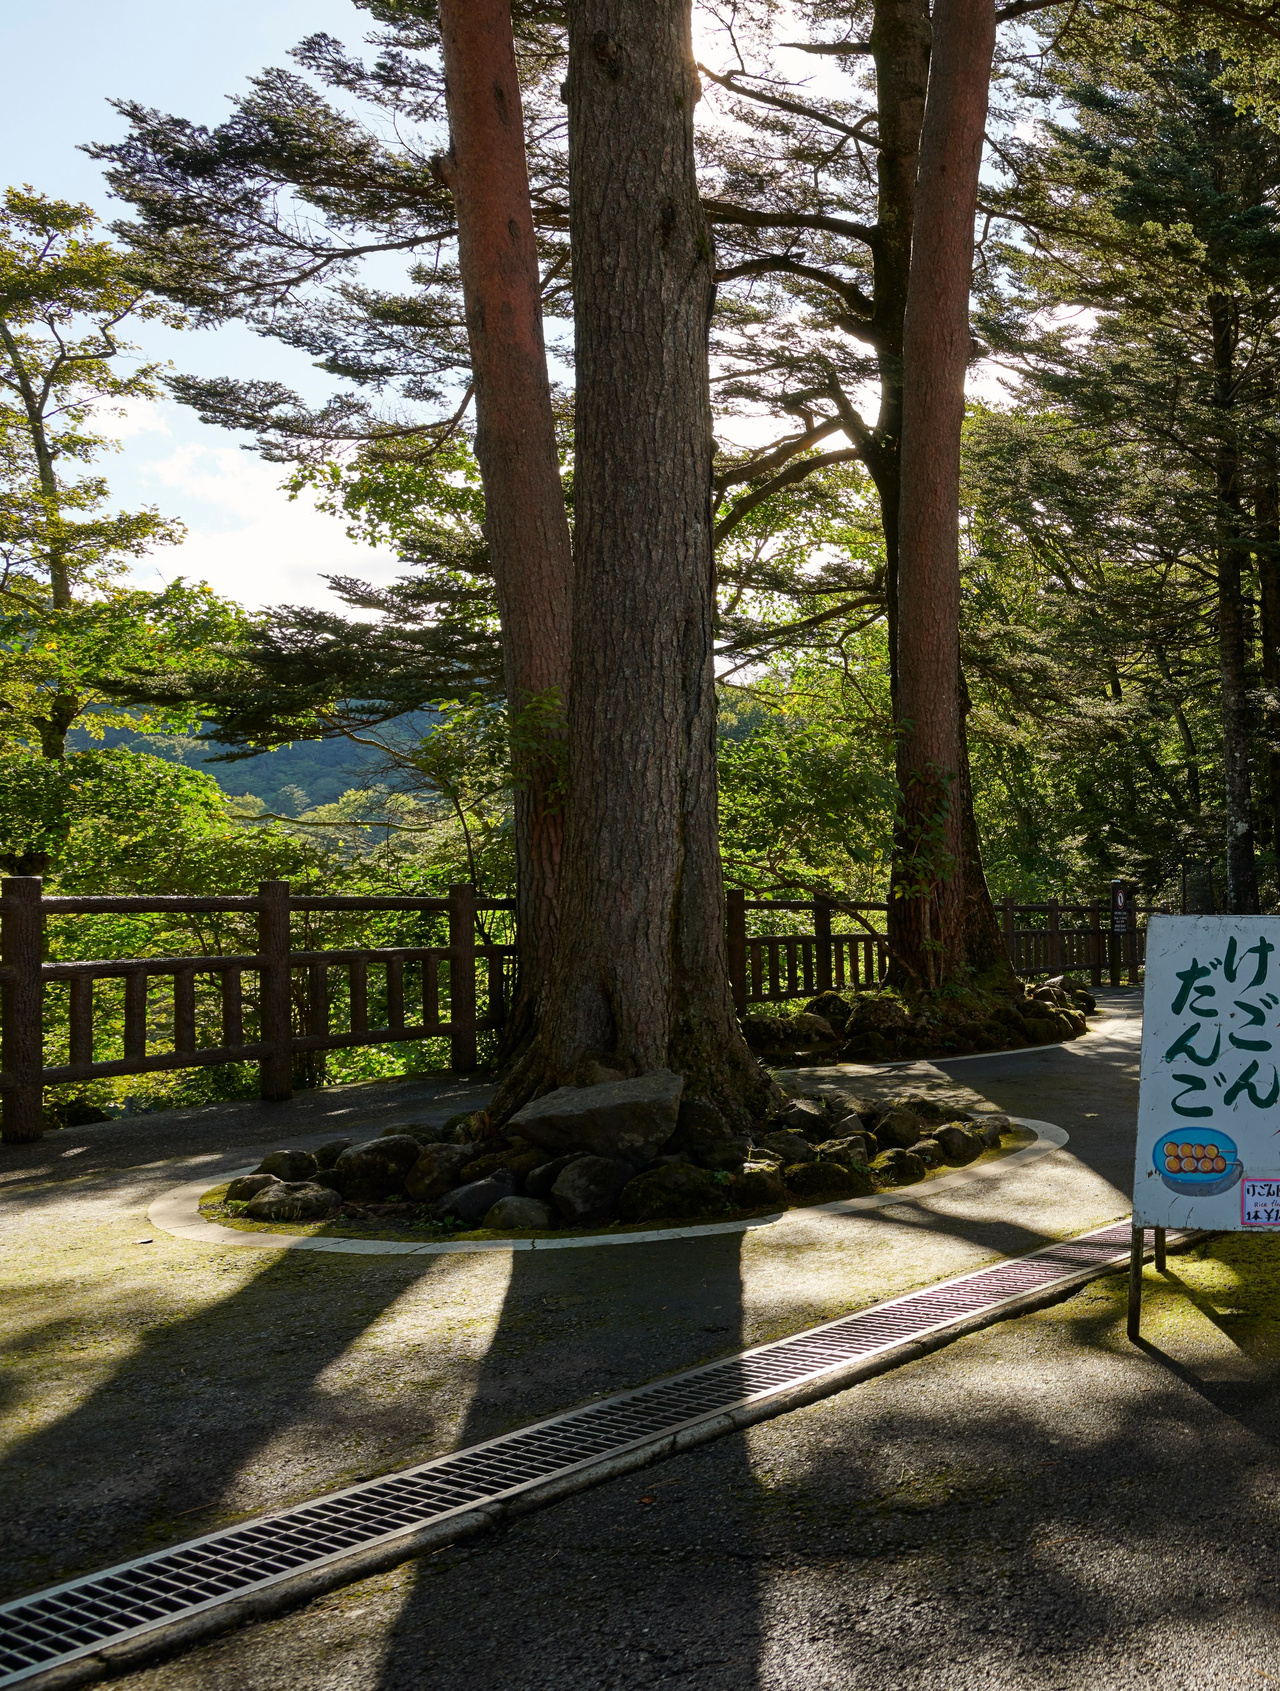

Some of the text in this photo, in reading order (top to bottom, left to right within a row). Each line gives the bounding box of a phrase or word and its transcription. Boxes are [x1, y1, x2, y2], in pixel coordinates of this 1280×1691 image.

[1164, 956, 1227, 1118] だんご
[1223, 935, 1280, 1110] けごん
[1246, 1210, 1263, 1221] 1本
